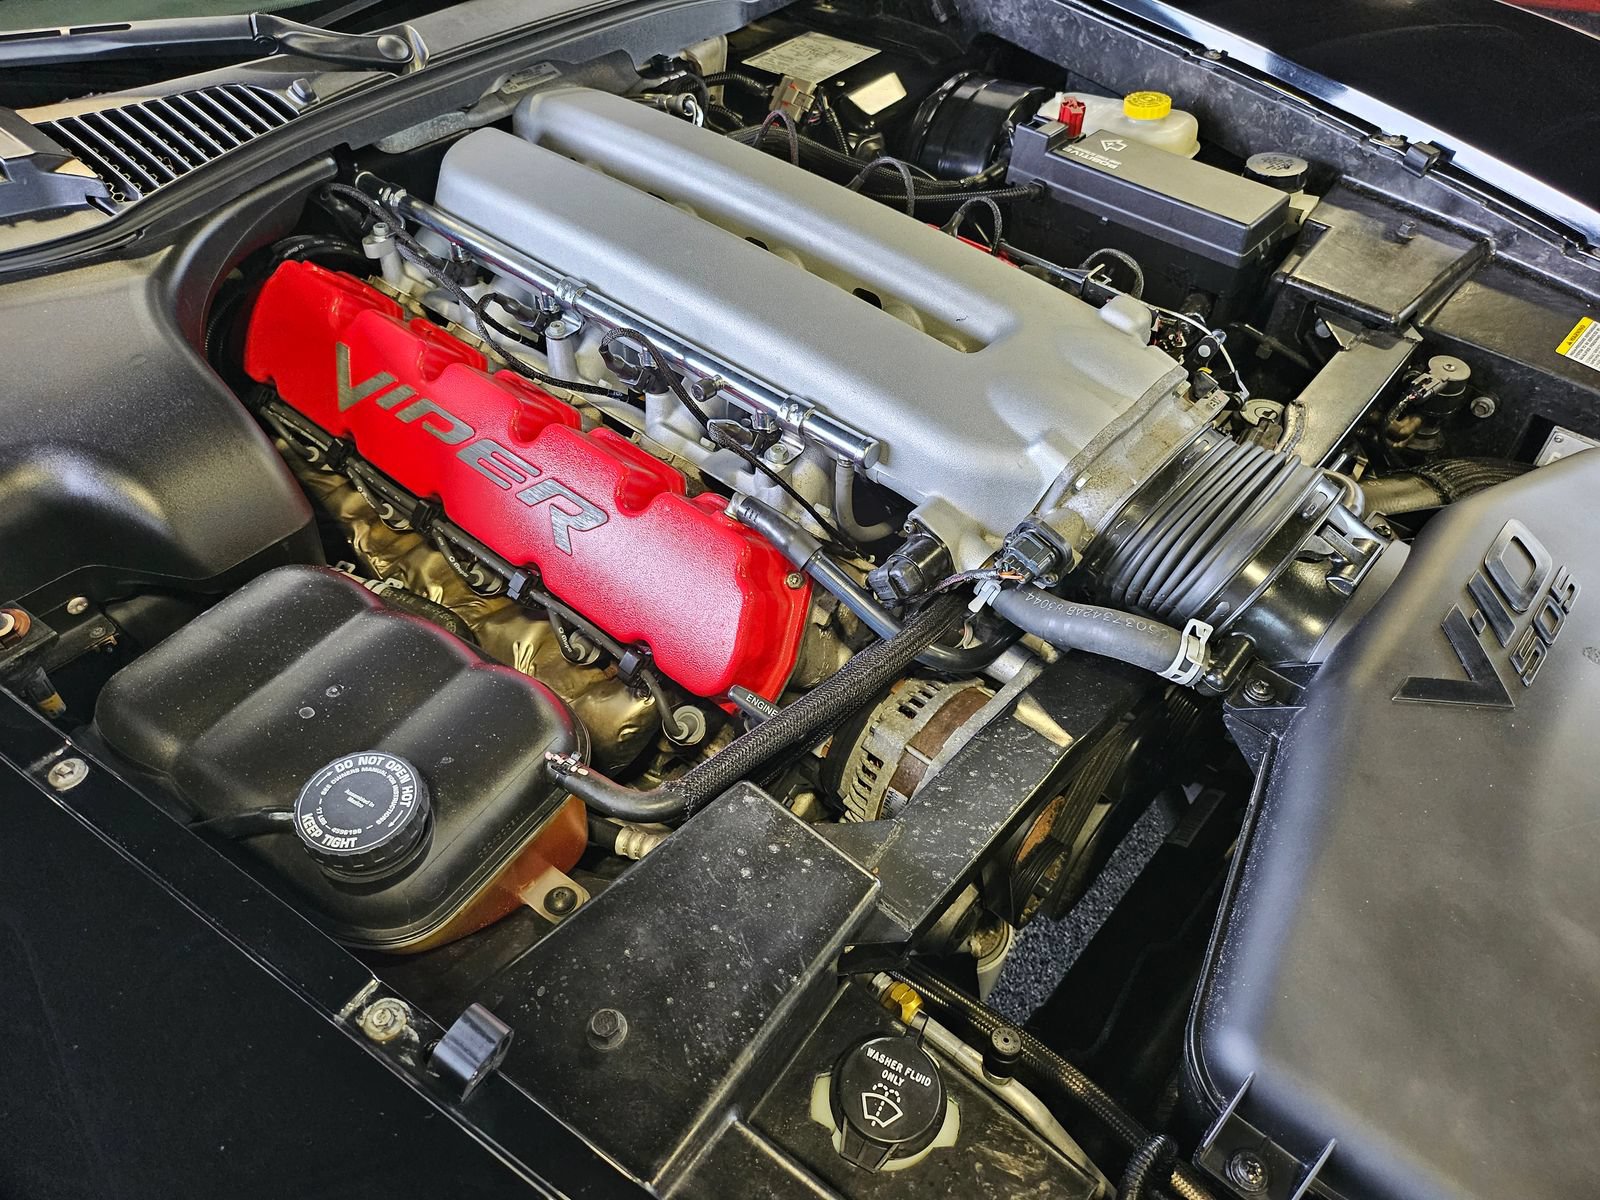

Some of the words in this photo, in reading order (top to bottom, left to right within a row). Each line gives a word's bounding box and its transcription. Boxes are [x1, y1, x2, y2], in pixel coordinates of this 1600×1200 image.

[1062, 146, 1119, 169] POSITIVE
[336, 341, 609, 556] VIPER
[1509, 565, 1581, 687] 505
[745, 693, 779, 717] ENGINE
[334, 759, 354, 774] DO
[358, 755, 385, 766] NOT
[385, 760, 412, 785] OPEN
[399, 785, 414, 808] HOT
[361, 766, 388, 777] MANUAL
[386, 775, 398, 786] FOR
[320, 783, 332, 796] SEE
[375, 784, 400, 825] INSTRUCTIONS
[301, 812, 323, 838] KEEP
[321, 833, 358, 849] TIGHT
[866, 1047, 904, 1073] WASHER
[904, 1066, 932, 1087] FLUID
[881, 1069, 905, 1087] ONLY
